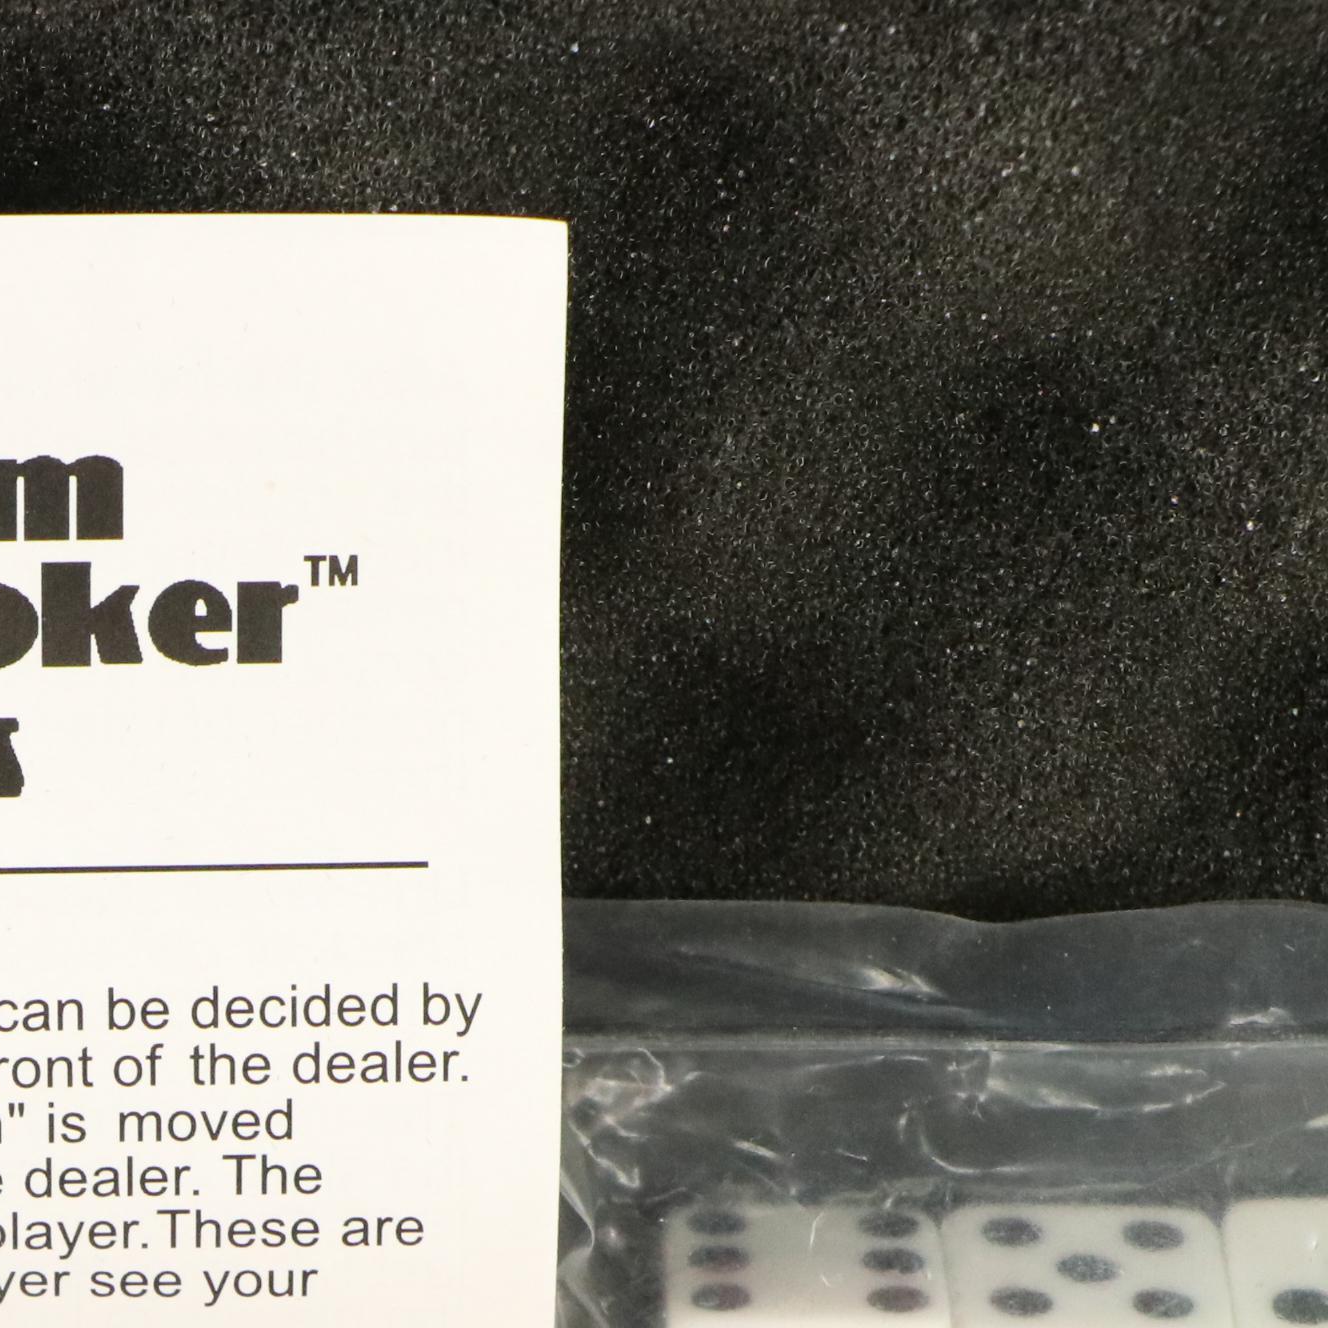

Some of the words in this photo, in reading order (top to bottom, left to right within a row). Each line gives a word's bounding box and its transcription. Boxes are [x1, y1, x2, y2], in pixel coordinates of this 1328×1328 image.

[107, 986, 170, 1031] be
[191, 982, 399, 1030] decided
[422, 981, 483, 1038] by
[113, 1042, 165, 1088] of
[189, 1042, 271, 1086] the
[292, 1039, 469, 1085] dealer.
[47, 1101, 87, 1144] is
[118, 1097, 293, 1143] moved
[24, 1155, 200, 1199] dealer.
[221, 1153, 323, 1196] The
[341, 1216, 424, 1247] are
[90, 1270, 182, 1298] see
[202, 1268, 319, 1308] your
